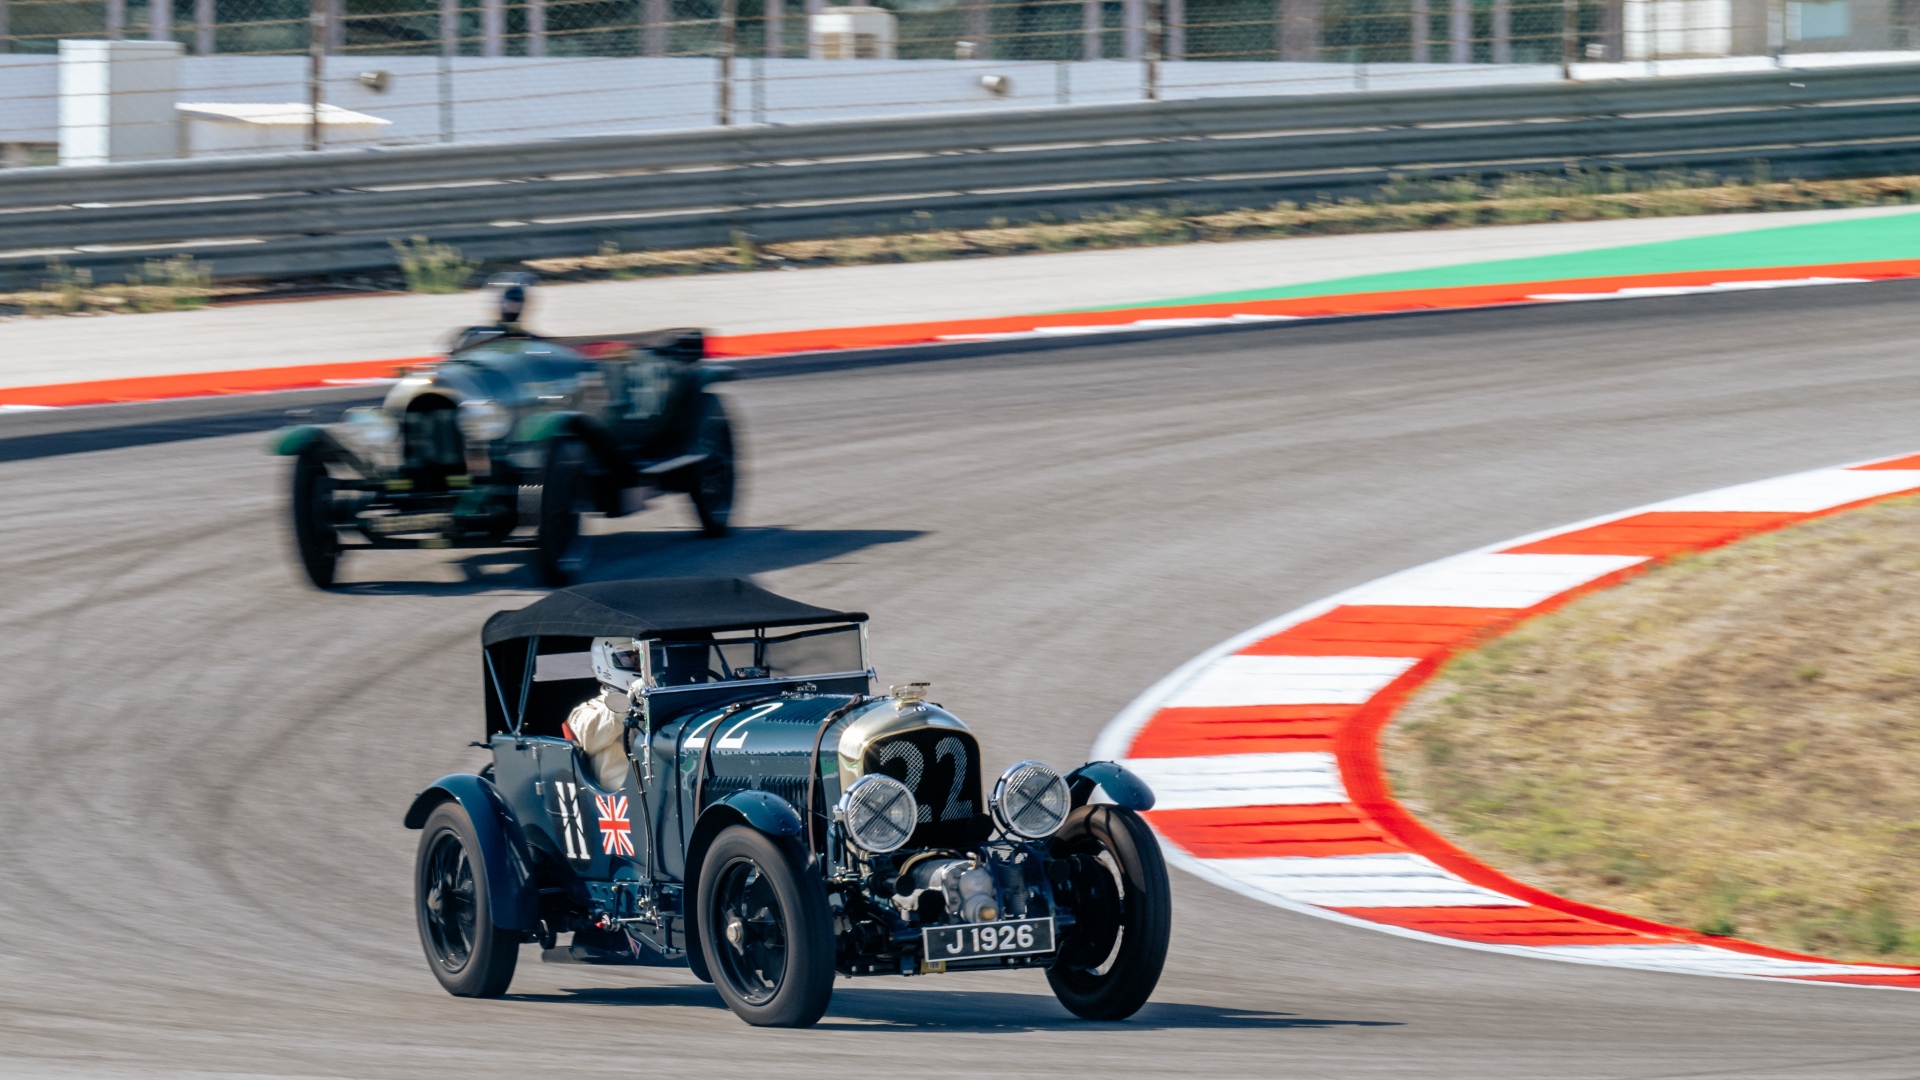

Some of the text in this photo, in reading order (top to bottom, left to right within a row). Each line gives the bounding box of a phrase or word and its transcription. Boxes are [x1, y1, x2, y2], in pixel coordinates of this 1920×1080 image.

[880, 737, 974, 823] 22
[946, 924, 1034, 954] J 1926
